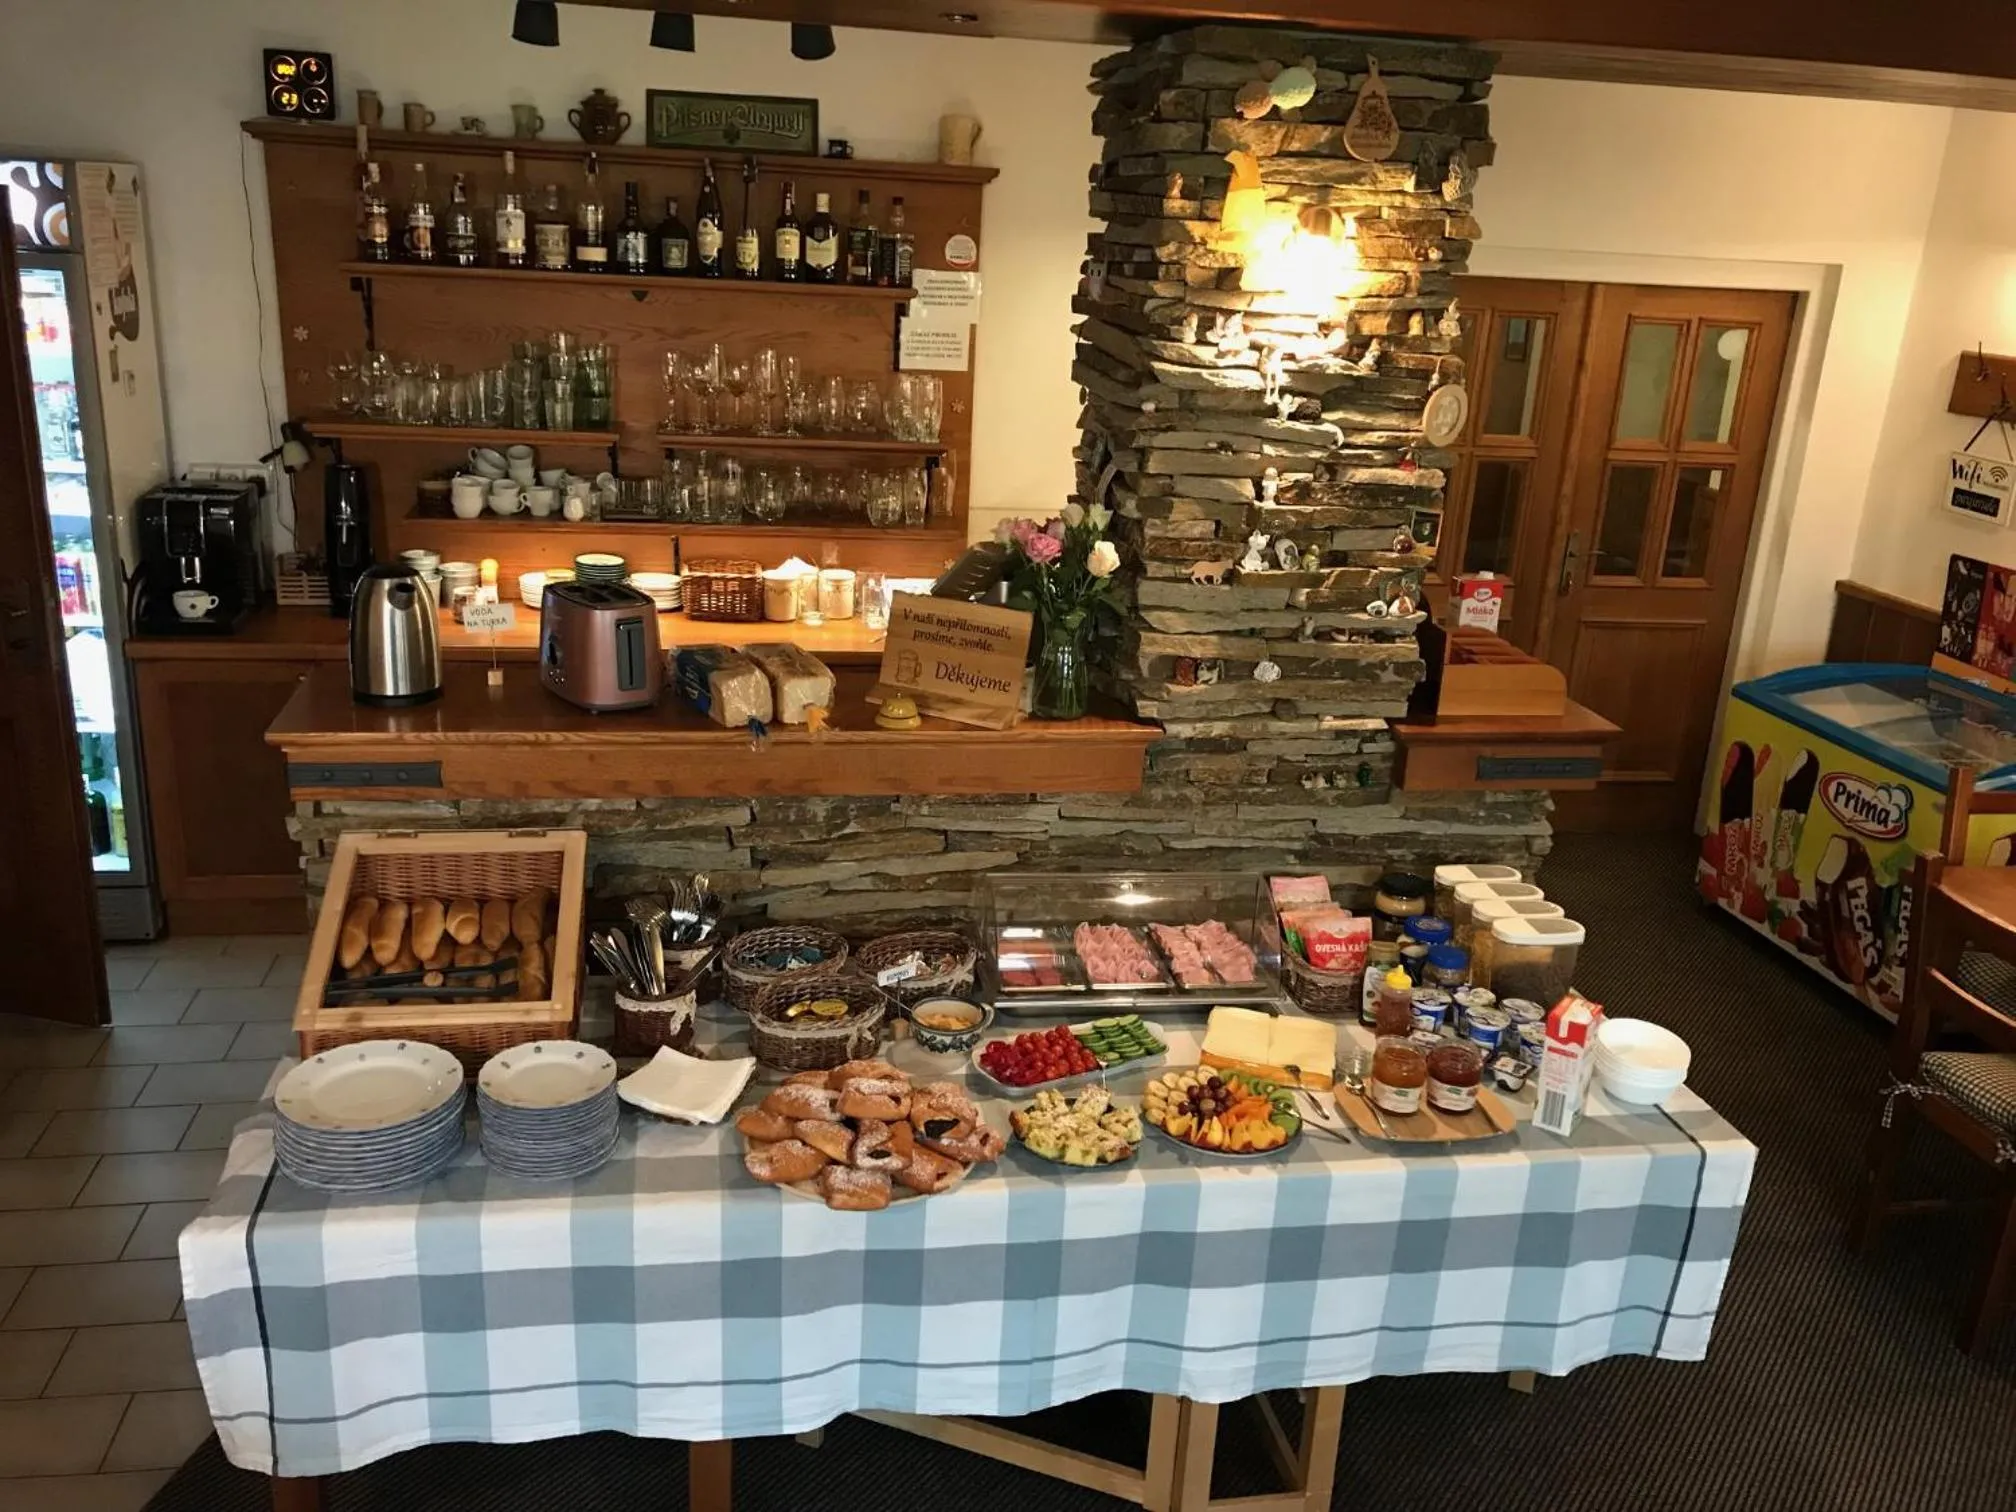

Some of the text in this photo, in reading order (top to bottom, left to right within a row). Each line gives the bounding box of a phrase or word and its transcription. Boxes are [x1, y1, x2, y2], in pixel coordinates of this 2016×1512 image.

[661, 103, 806, 138] Pilsner Urquell
[1952, 458, 1984, 489] Wifi
[903, 607, 913, 621] V
[935, 661, 1011, 693] Děkujeme
[1834, 781, 1891, 828] Prima
